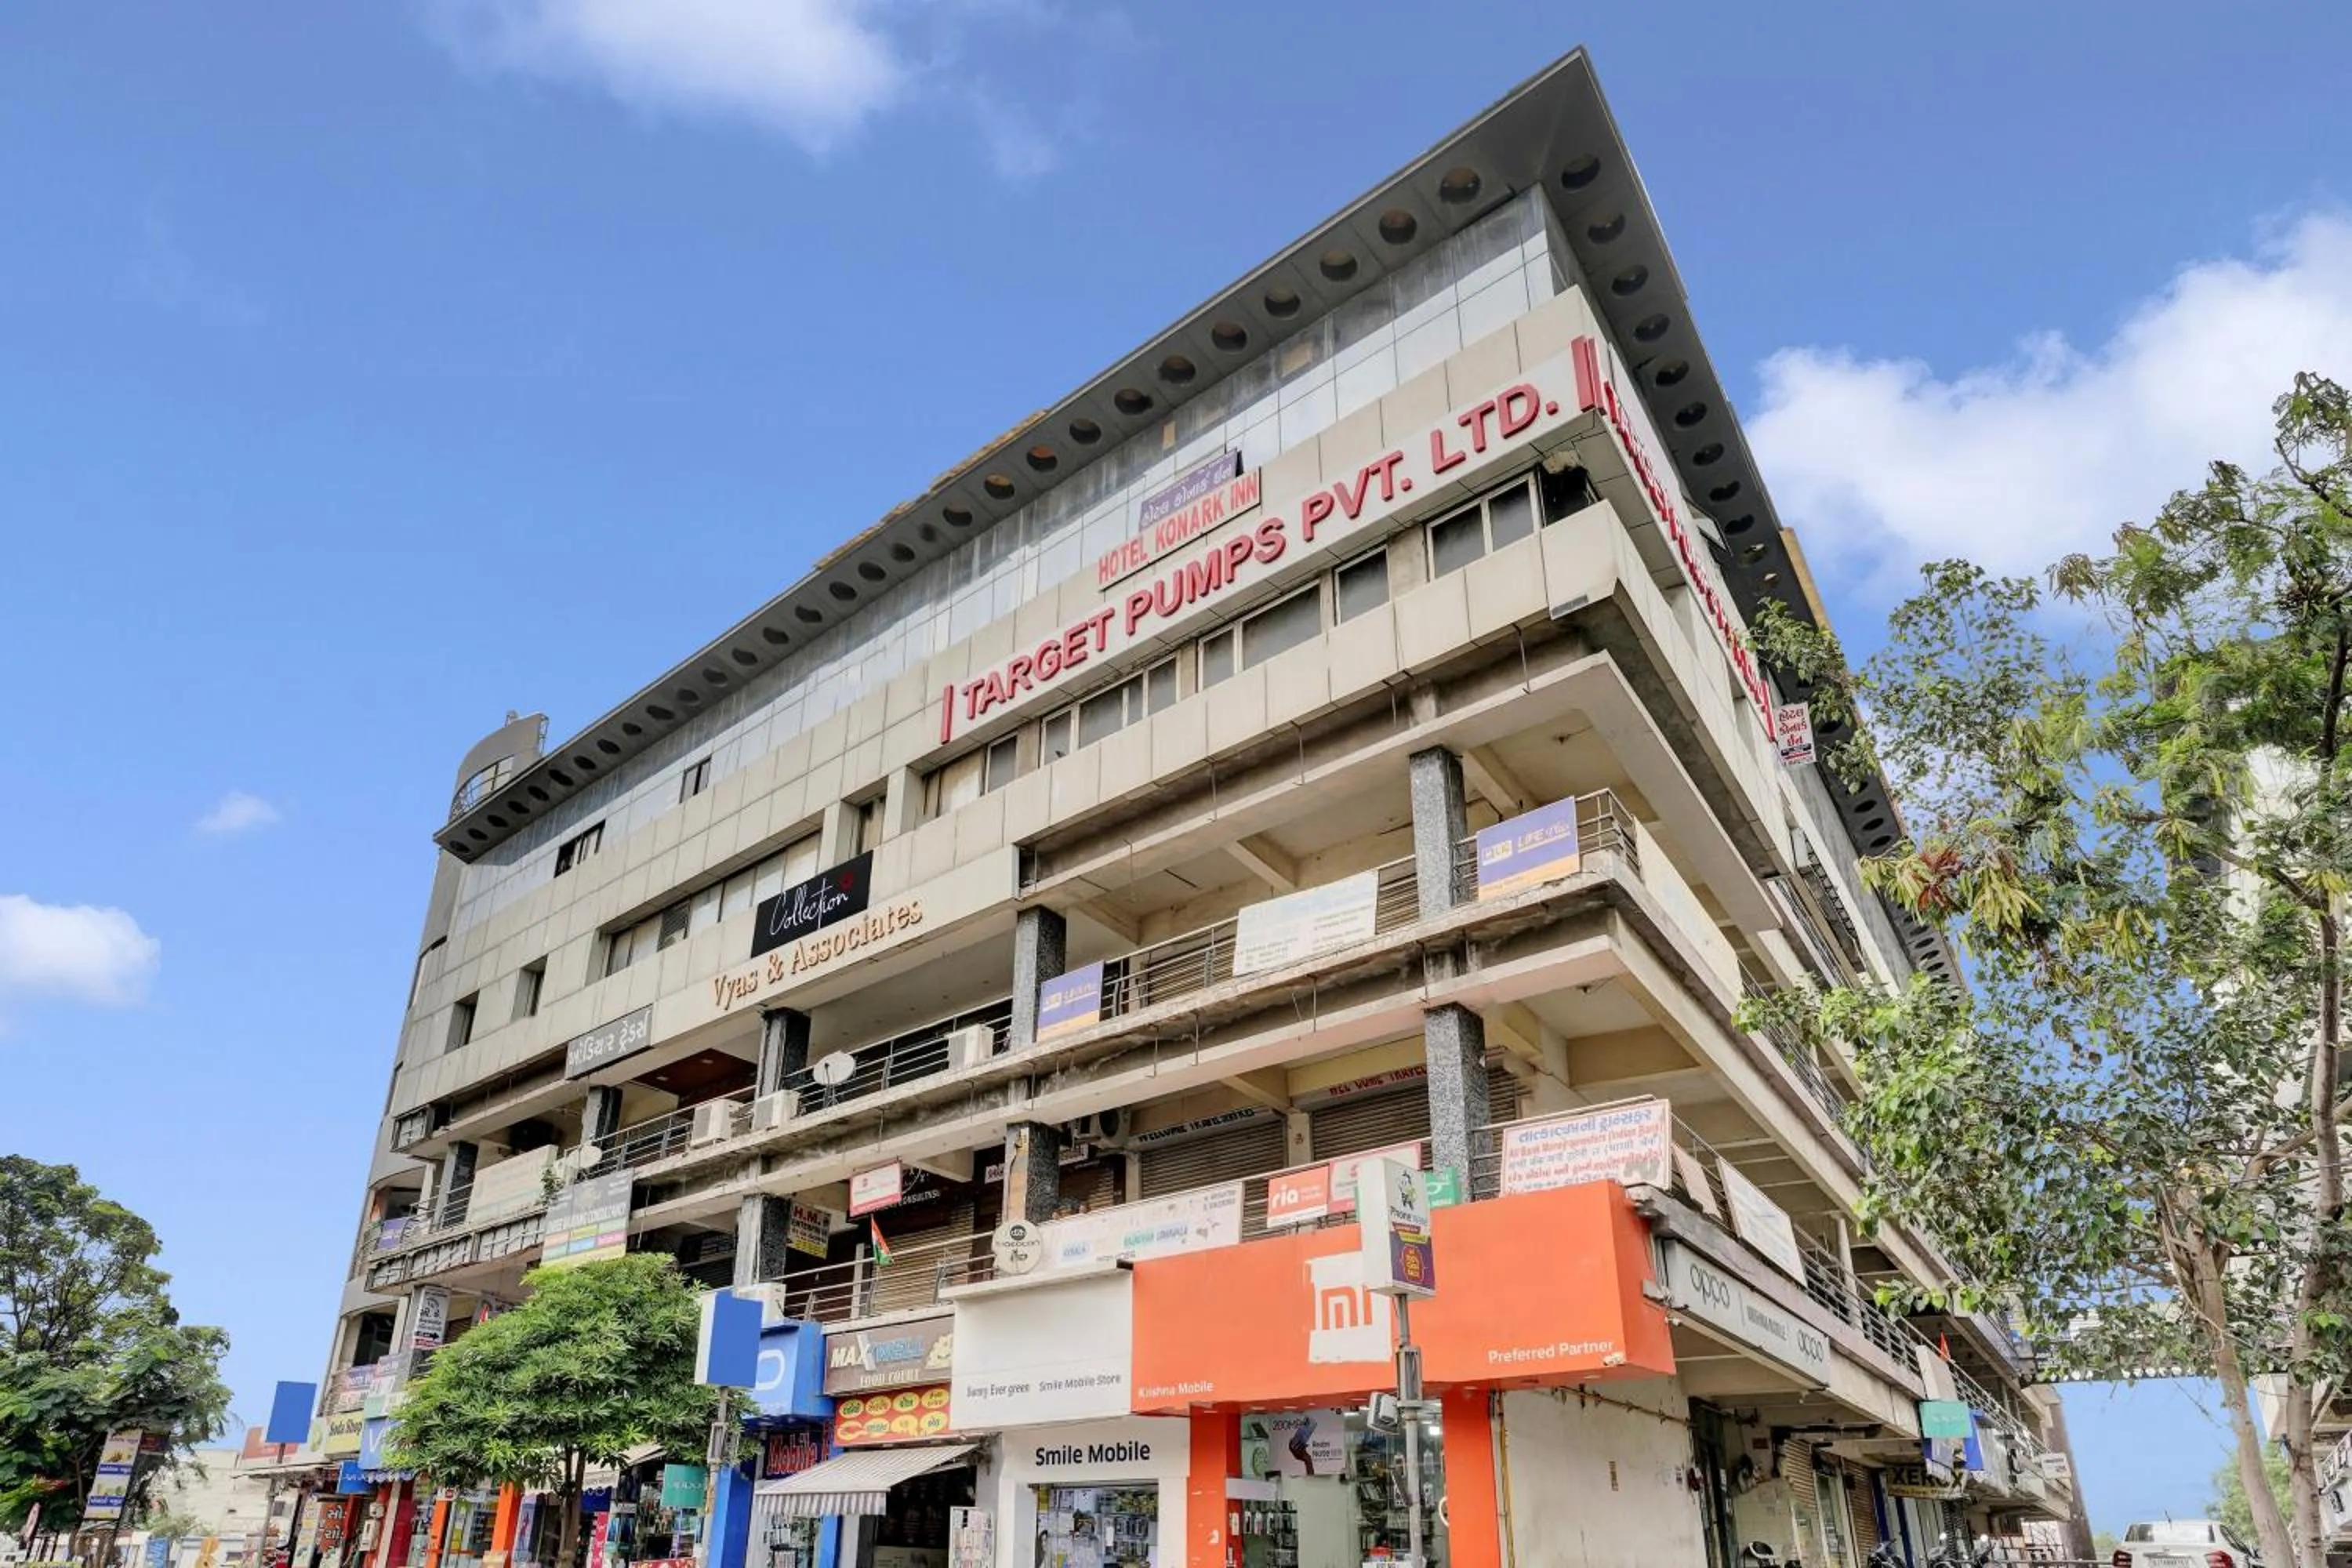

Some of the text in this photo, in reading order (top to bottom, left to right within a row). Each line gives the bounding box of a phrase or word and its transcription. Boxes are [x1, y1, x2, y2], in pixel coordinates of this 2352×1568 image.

[1099, 472, 1259, 584] HOTEL KONARK INN
[963, 383, 1559, 720] TARGET PUMPS PVT. LTD.
[771, 877, 848, 935] Collection
[713, 900, 924, 1010] Vyas & Associates
[1272, 1185, 1299, 1208] ria
[1488, 1341, 1614, 1364] Preferred Partner
[1039, 1381, 1061, 1392] Smile
[1064, 1377, 1094, 1388] Mobile
[1097, 1374, 1121, 1386] Store
[1138, 1380, 1214, 1399] Krishna Mobile
[1036, 1441, 1151, 1466] Smile Mobile
